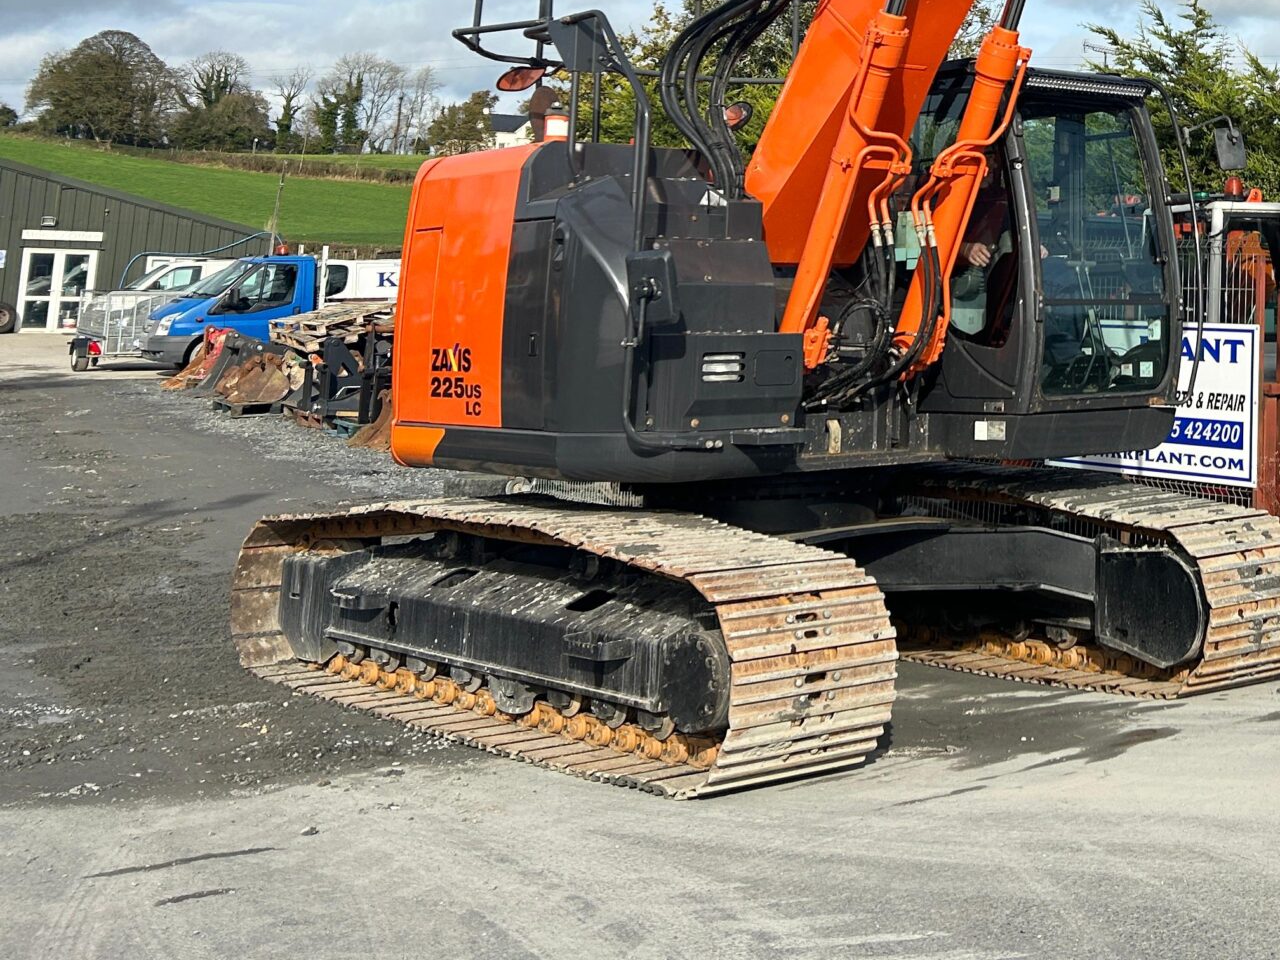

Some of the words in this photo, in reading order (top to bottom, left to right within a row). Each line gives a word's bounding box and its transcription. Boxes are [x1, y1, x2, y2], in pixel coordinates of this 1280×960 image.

[432, 343, 471, 372] ZAXIS
[465, 401, 481, 416] LC
[1196, 392, 1204, 409] &
[1206, 392, 1246, 412] REPAIR
[1184, 421, 1241, 443] 424200
